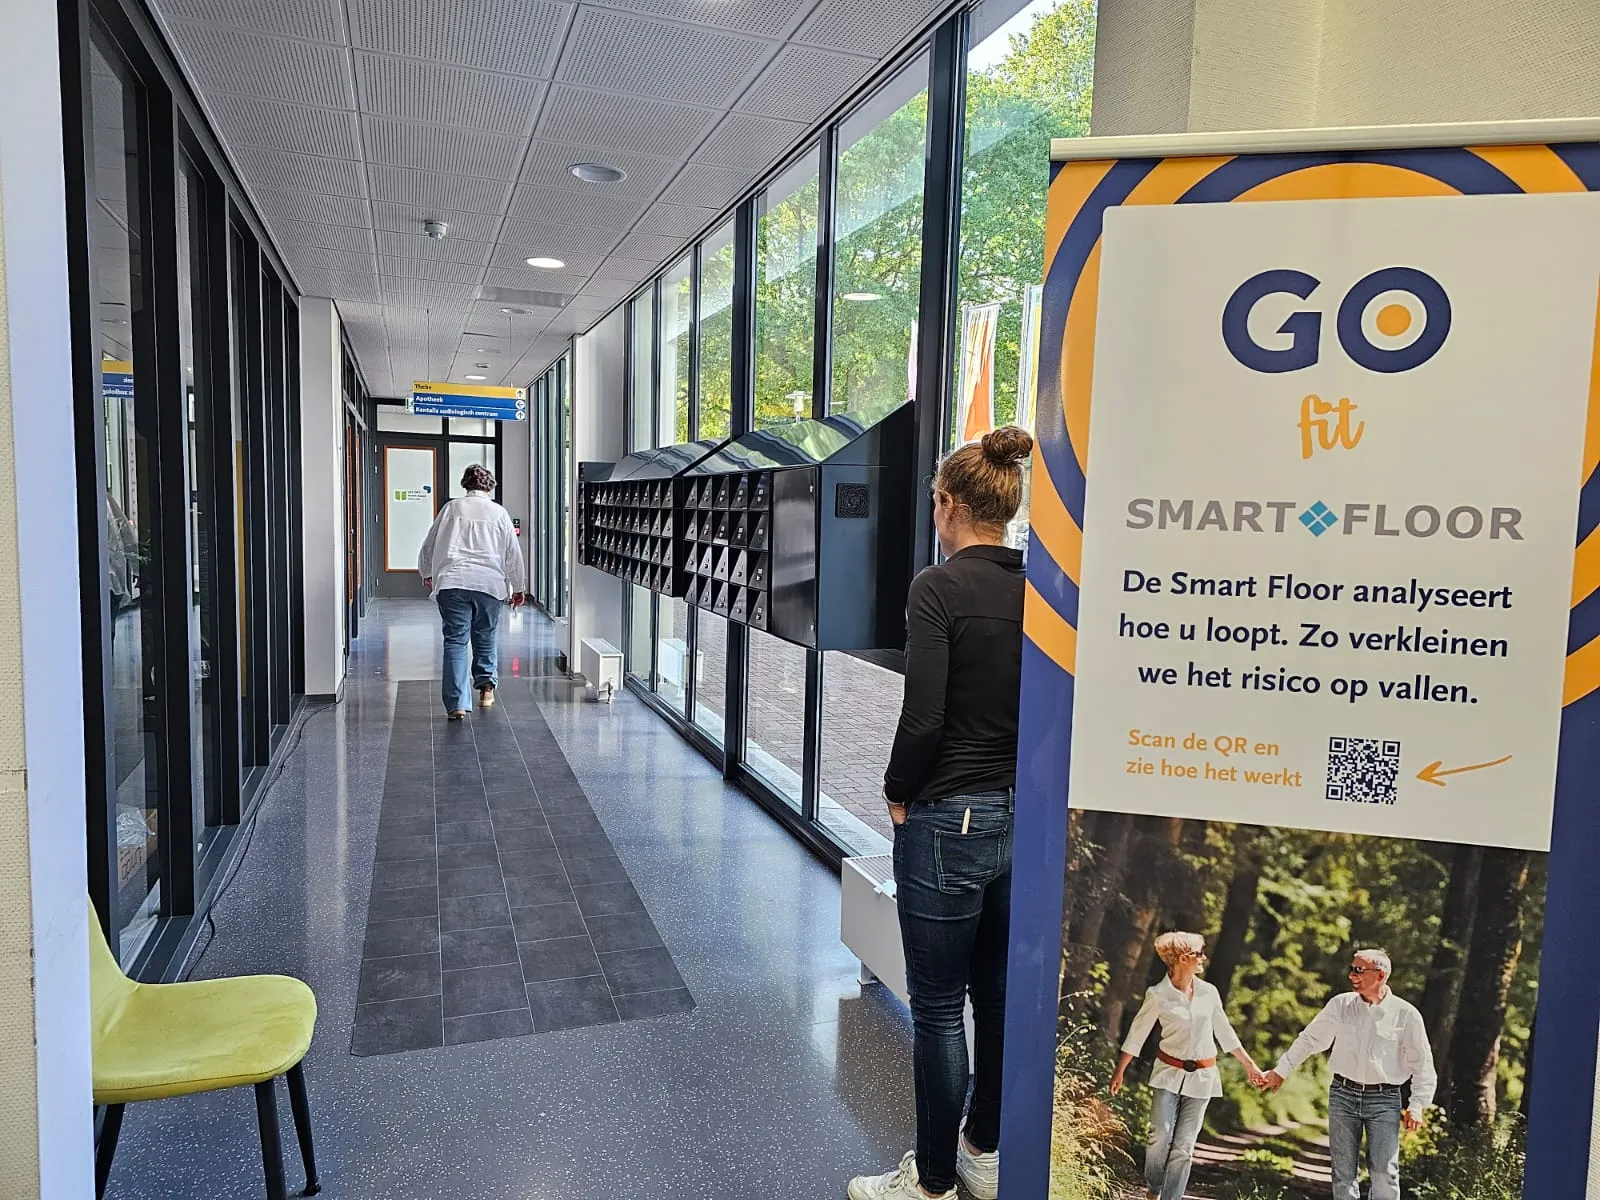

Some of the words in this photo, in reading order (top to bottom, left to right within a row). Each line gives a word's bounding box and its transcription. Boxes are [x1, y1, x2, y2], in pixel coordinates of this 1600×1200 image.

[1222, 267, 1451, 373] GO
[415, 395, 444, 403] Apotheek
[1298, 394, 1364, 459] fit
[1126, 499, 1296, 532] SMART
[1343, 504, 1524, 540] FLOOR
[1124, 570, 1161, 593] De
[1170, 572, 1257, 597] Smart
[1269, 574, 1344, 600] Floor
[1353, 579, 1512, 612] analyseert
[1120, 613, 1169, 639] hoe
[1180, 624, 1195, 640] u
[1207, 617, 1287, 651] loopt.
[1299, 624, 1338, 647] Zo
[1349, 626, 1507, 657] verkleinen
[1138, 667, 1177, 684] we
[1188, 662, 1232, 688] het
[1242, 666, 1320, 693] risico
[1331, 679, 1368, 703] op
[1379, 675, 1477, 703] vallen.
[1128, 728, 1176, 748] Scan
[1183, 732, 1208, 751] de
[1214, 735, 1248, 757] QR
[1255, 743, 1280, 755] en
[1127, 757, 1154, 774] zie
[1161, 759, 1198, 779] hoe
[1205, 762, 1237, 782] het
[1244, 768, 1302, 787] werkt
